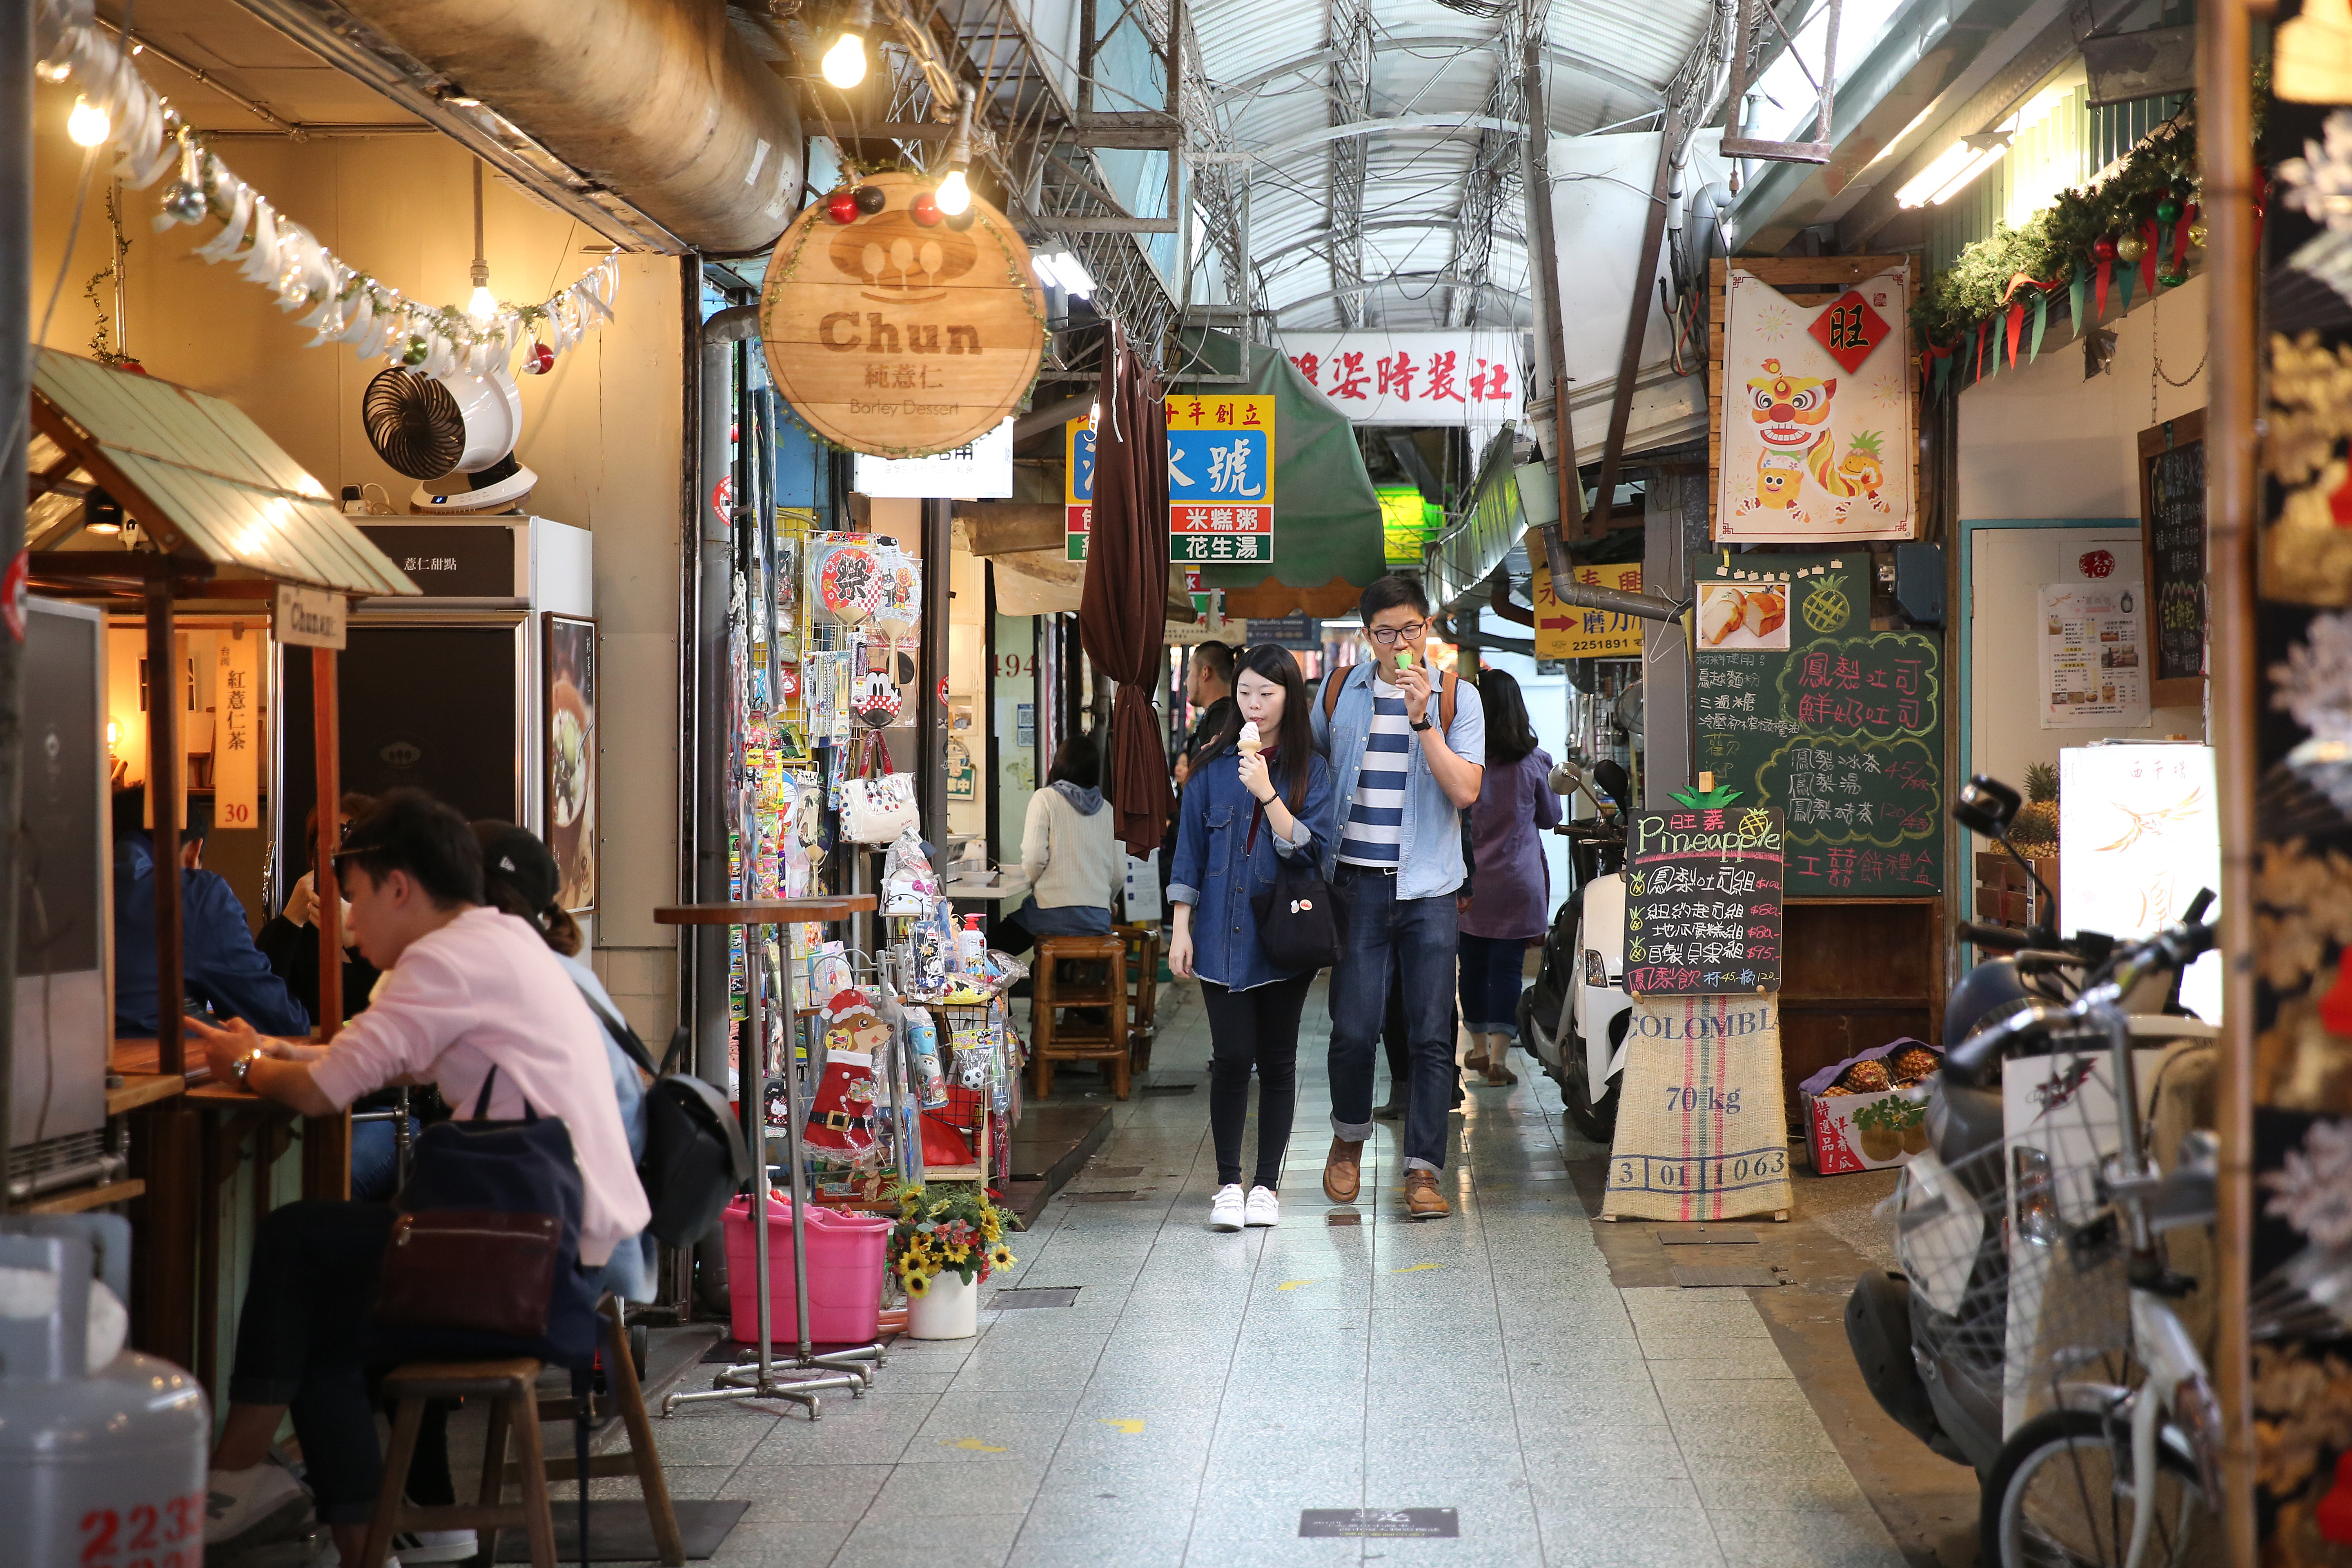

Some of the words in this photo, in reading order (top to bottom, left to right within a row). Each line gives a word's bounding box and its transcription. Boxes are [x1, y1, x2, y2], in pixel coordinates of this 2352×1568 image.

[819, 312, 982, 355] Chun
[1829, 304, 1870, 351] 旺
[865, 364, 943, 389] 純薏仁
[851, 399, 898, 416] Barley
[904, 401, 959, 415] Dessert
[1186, 508, 1258, 531] 米糕粥
[1186, 536, 1258, 559] 花生湯
[404, 557, 457, 570] 薏仁甜點
[1573, 639, 1628, 650] 2251891
[1799, 653, 1921, 695] 鳳梨吐司
[227, 670, 246, 751] 紅薏仁茶
[1799, 692, 1919, 728] 鮮奶吐司
[1792, 748, 1881, 774] 鳳梨冰茶
[2130, 760, 2188, 780] 西市場
[1789, 772, 1862, 797] 鳳梨湯
[225, 804, 248, 822] 30
[1636, 816, 1781, 863] Pineapple
[1647, 866, 1755, 895] 鳳梨吐司組
[1645, 901, 1744, 920] 紐約起司組
[1653, 922, 1744, 939] 地瓜蛋糕組
[1648, 940, 1744, 965] 自製貝果組
[1628, 967, 1701, 991] 鳳梨飲
[1703, 971, 1721, 987] 杯
[1666, 1087, 1697, 1111] 70
[1708, 1086, 1741, 1114] kg
[1834, 1116, 1853, 1169] 洋香瓜
[1619, 1162, 1633, 1183] 3
